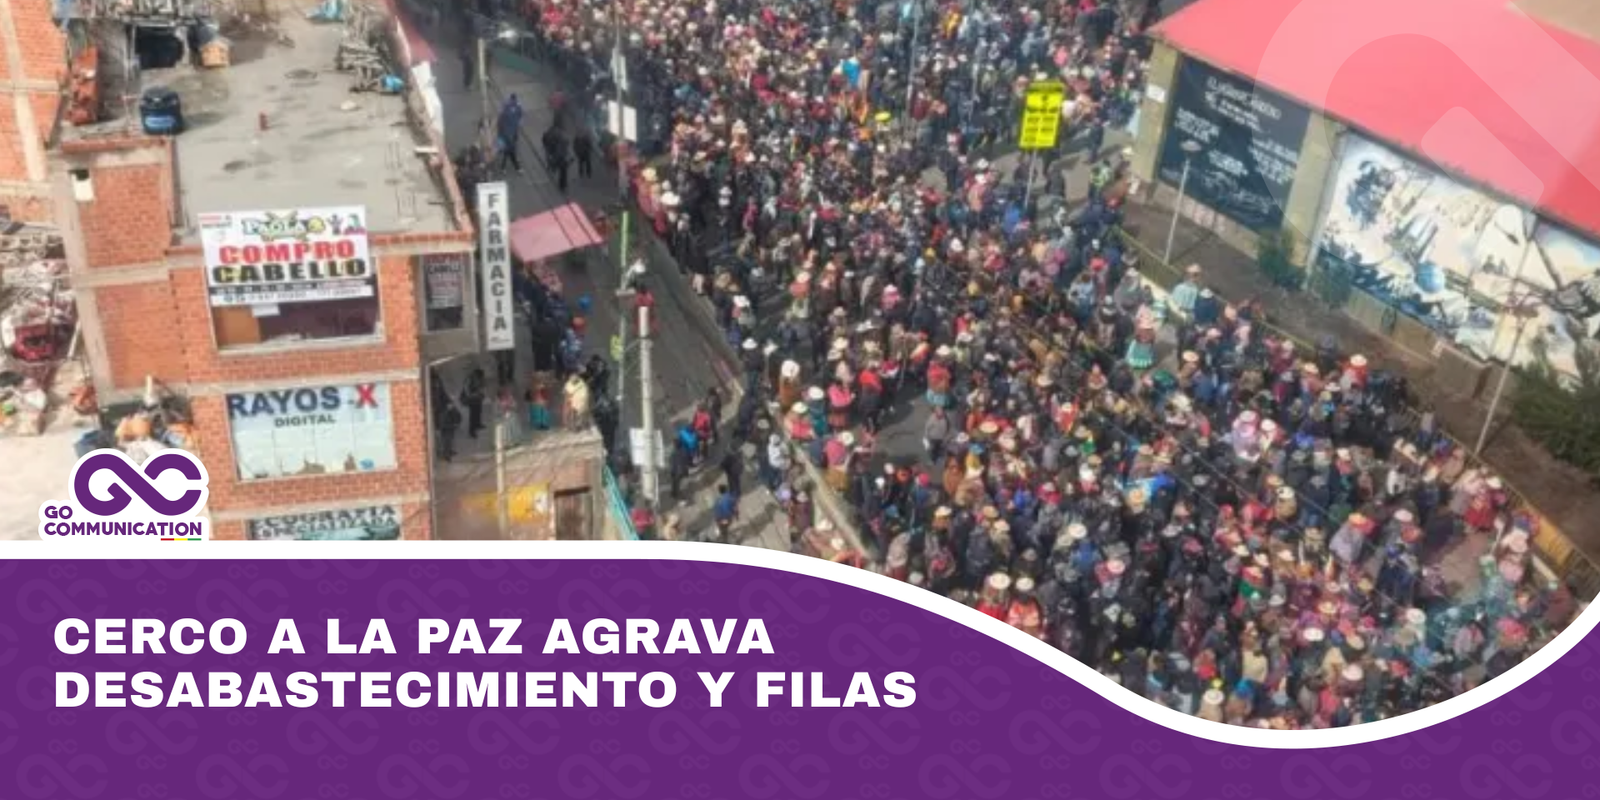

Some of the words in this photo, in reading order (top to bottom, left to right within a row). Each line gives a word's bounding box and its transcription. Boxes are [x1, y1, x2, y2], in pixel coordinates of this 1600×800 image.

[219, 240, 355, 264] COMPRO
[486, 193, 507, 331] FARMACIA
[212, 258, 366, 283] CABELLO
[225, 386, 341, 418] RAYOS
[274, 415, 336, 428] DIGITAL
